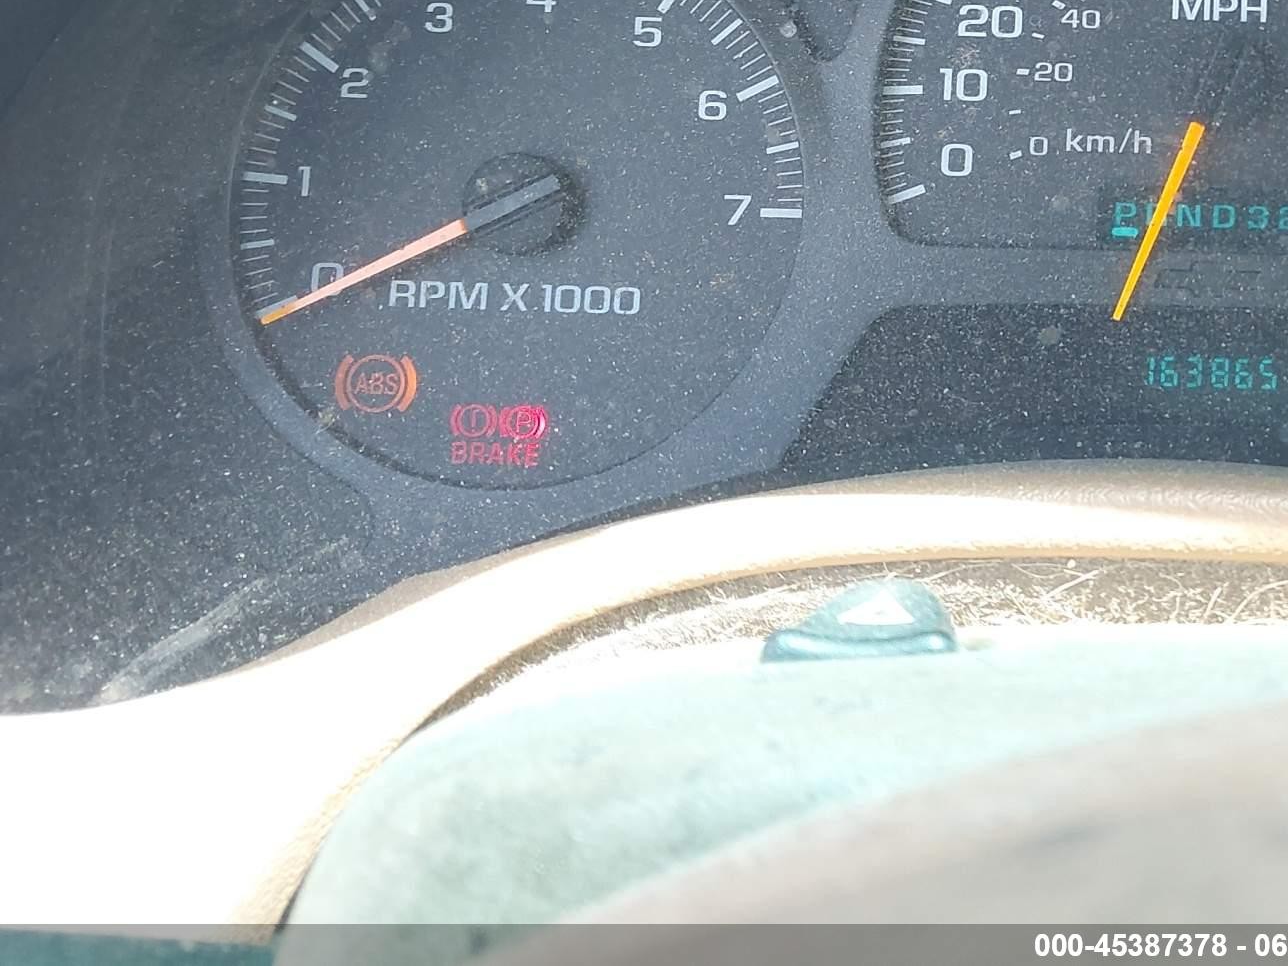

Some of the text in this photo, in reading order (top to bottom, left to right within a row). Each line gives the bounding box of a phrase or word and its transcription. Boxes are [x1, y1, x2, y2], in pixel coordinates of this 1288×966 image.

[425, 3, 453, 32] 3
[633, 17, 662, 47] 5
[957, 4, 1024, 38] 20
[1061, 8, 1101, 29] 40
[340, 69, 368, 98] 2
[939, 68, 988, 101] 10
[1033, 62, 1073, 82] 20
[700, 91, 726, 121] 6
[1029, 135, 1048, 155] 0
[1065, 129, 1153, 155] km/h
[940, 143, 973, 177] 0
[297, 167, 310, 195] 1
[723, 195, 752, 225] 7
[311, 263, 344, 296] 0
[388, 280, 641, 315] RPM X 1000
[353, 372, 399, 395] ABS
[1144, 356, 1277, 389] 163865
[451, 440, 541, 467] BRAKE
